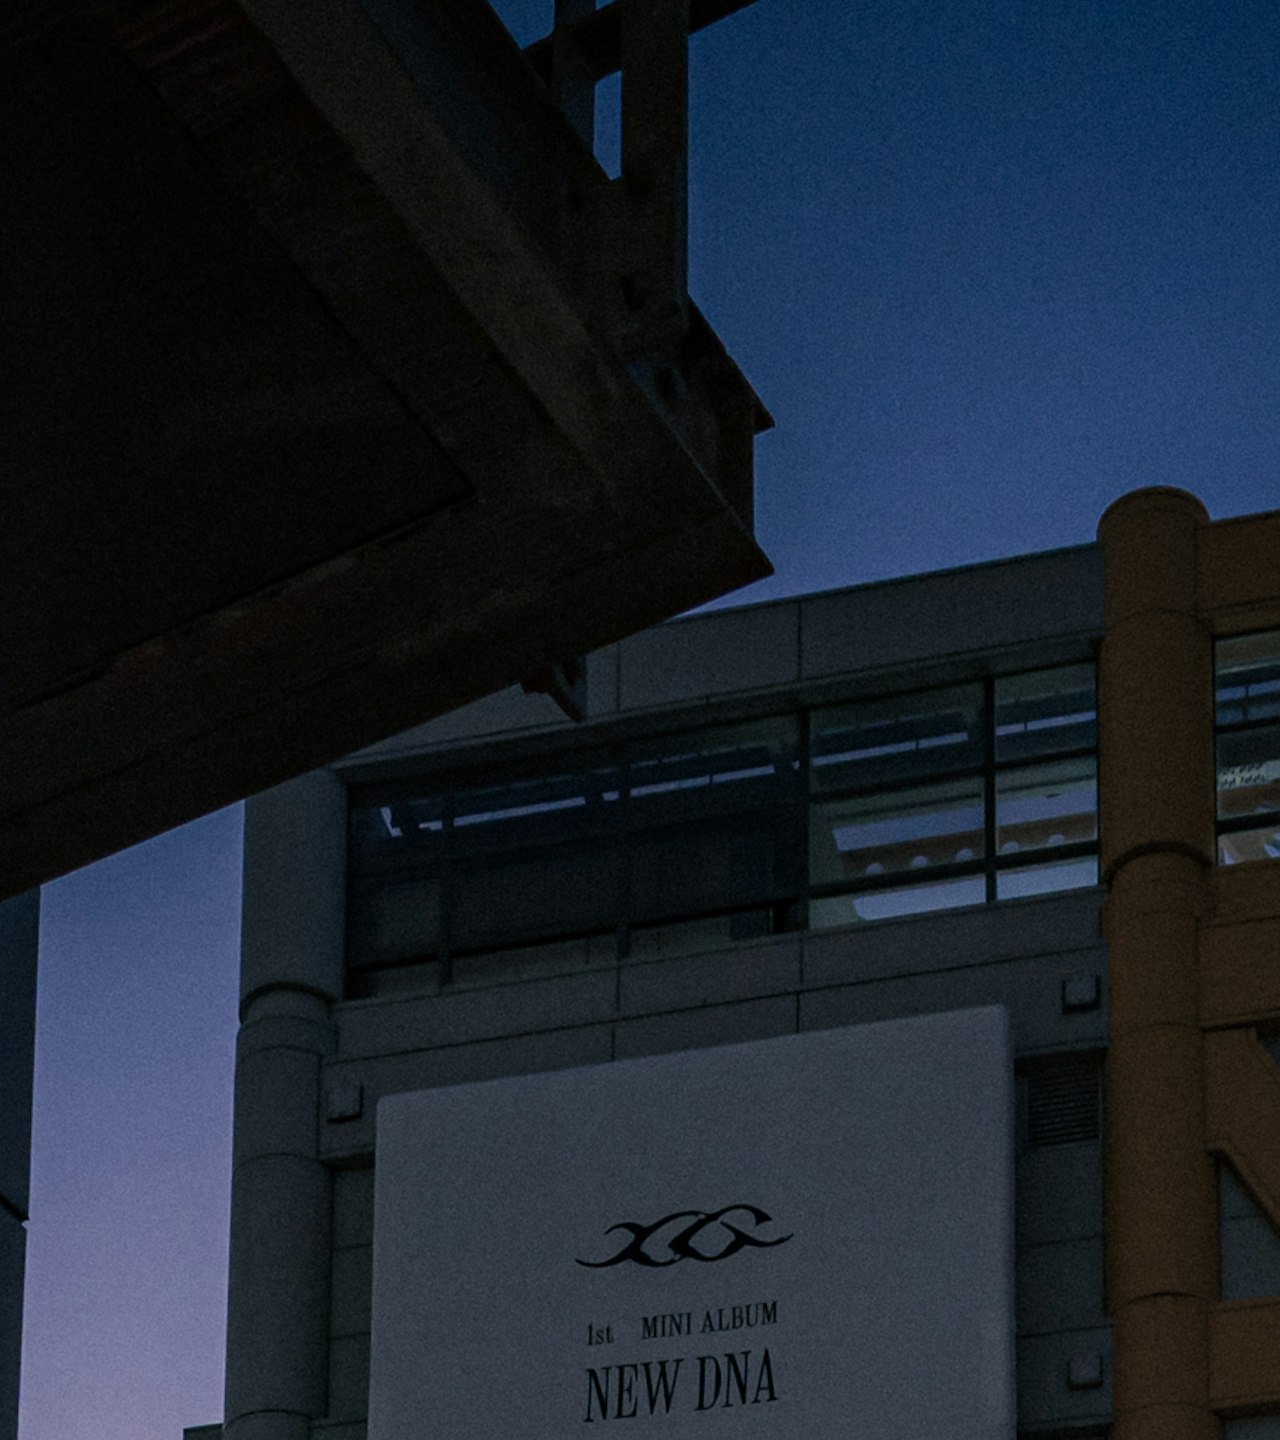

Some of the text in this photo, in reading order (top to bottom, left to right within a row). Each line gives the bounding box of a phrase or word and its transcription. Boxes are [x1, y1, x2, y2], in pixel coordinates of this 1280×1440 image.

[587, 1301, 778, 1346] 1st MINI ALBUM
[584, 1348, 778, 1423] NEW DNA
